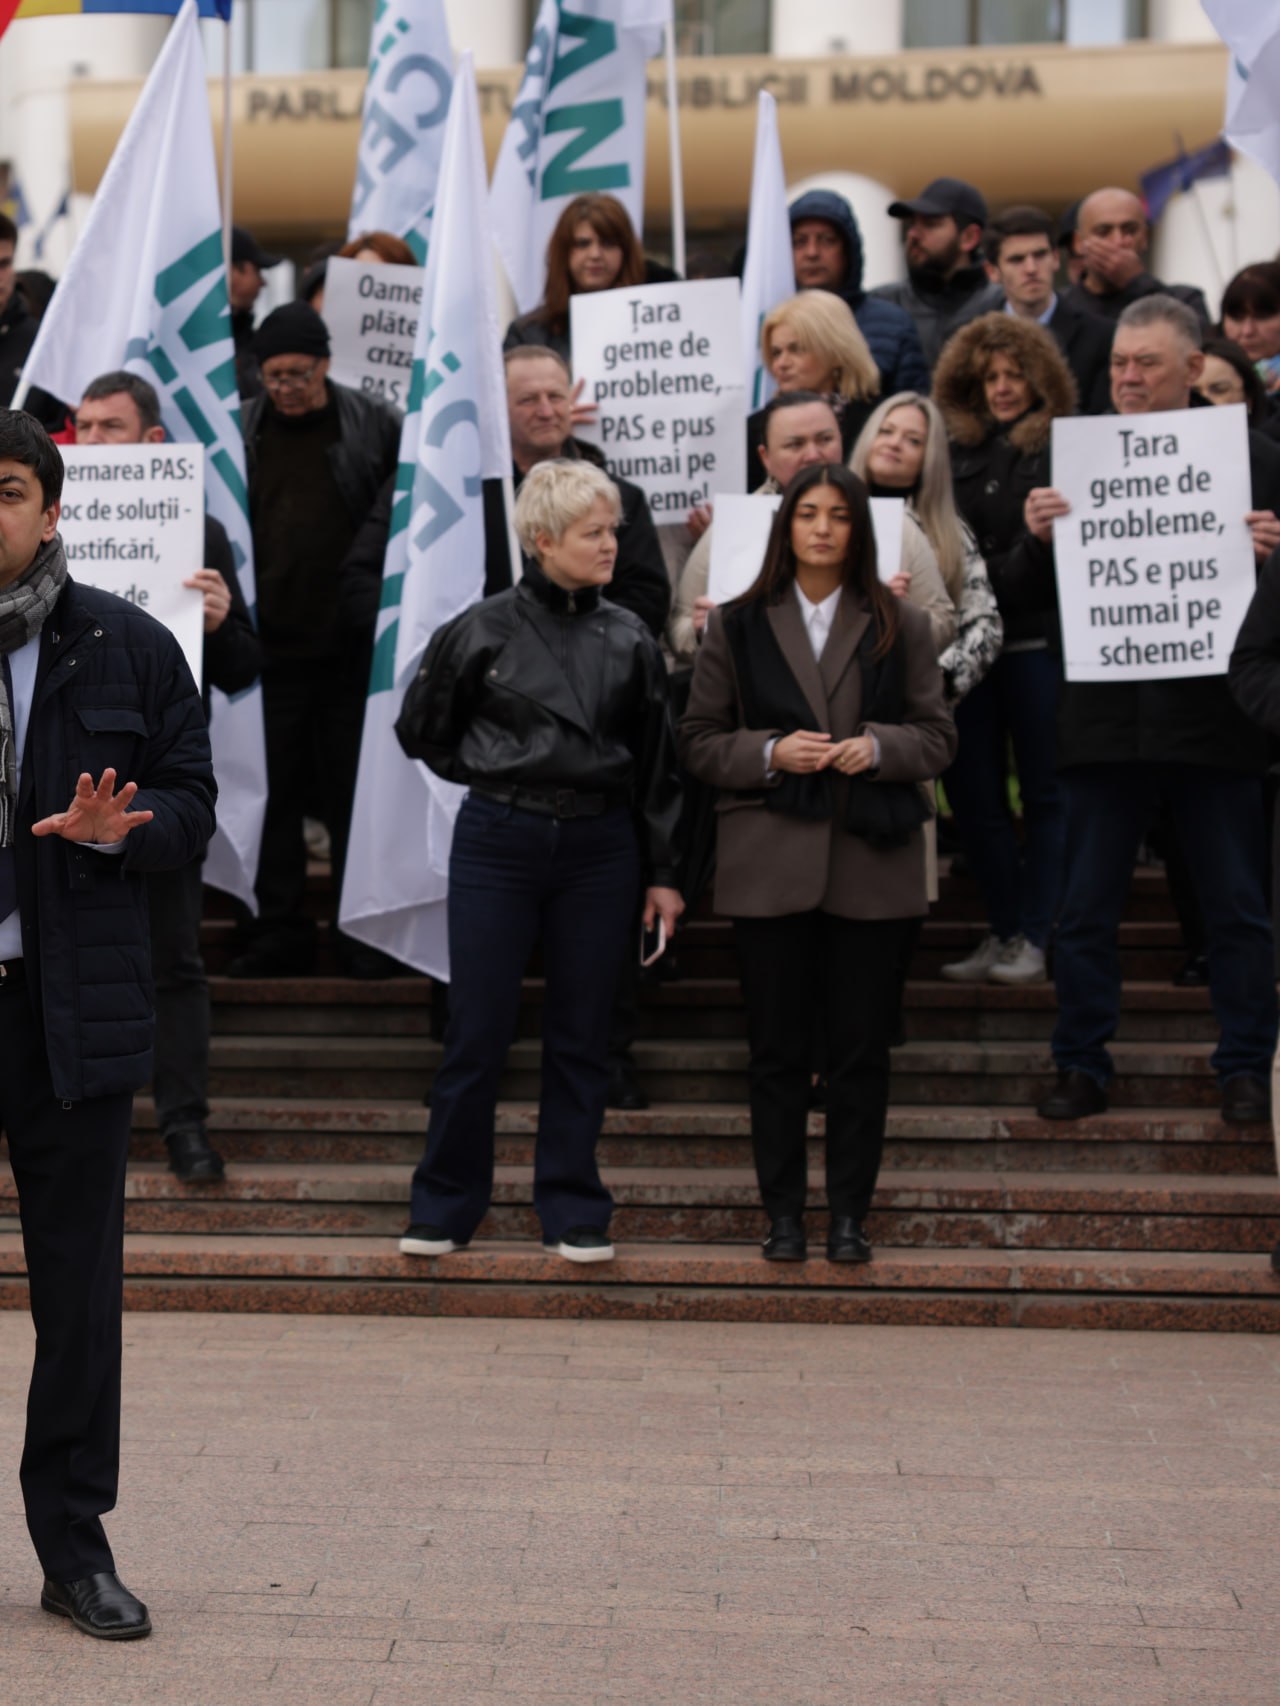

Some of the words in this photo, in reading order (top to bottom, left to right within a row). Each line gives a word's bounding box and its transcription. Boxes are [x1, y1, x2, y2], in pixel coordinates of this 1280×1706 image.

[831, 65, 1042, 103] MOLDOVA
[358, 274, 423, 304] Oame
[360, 308, 418, 338] plăte
[629, 300, 681, 333] Țara
[603, 338, 673, 371] geme
[679, 330, 711, 358] de
[594, 369, 722, 404] probleme,
[601, 414, 645, 442] PAS
[652, 421, 666, 439] e
[672, 416, 715, 445] pus
[605, 448, 681, 477] numai
[687, 451, 716, 480] pe
[1118, 429, 1179, 468] Țara
[64, 462, 145, 482] ernarea
[150, 457, 195, 481] PAS:
[650, 482, 709, 512] eme!
[1090, 474, 1170, 508] geme
[1177, 465, 1211, 494] de
[60, 503, 82, 521] oc
[86, 498, 112, 521] de
[116, 498, 180, 527] soluții
[1080, 508, 1226, 547] probleme,
[65, 538, 161, 563] ustificări,
[1088, 557, 1139, 588] PAS
[1146, 562, 1162, 585] e
[1169, 557, 1219, 591] pus
[1090, 593, 1179, 627] numai
[1187, 597, 1222, 630] pe
[1100, 631, 1215, 666] scheme!
